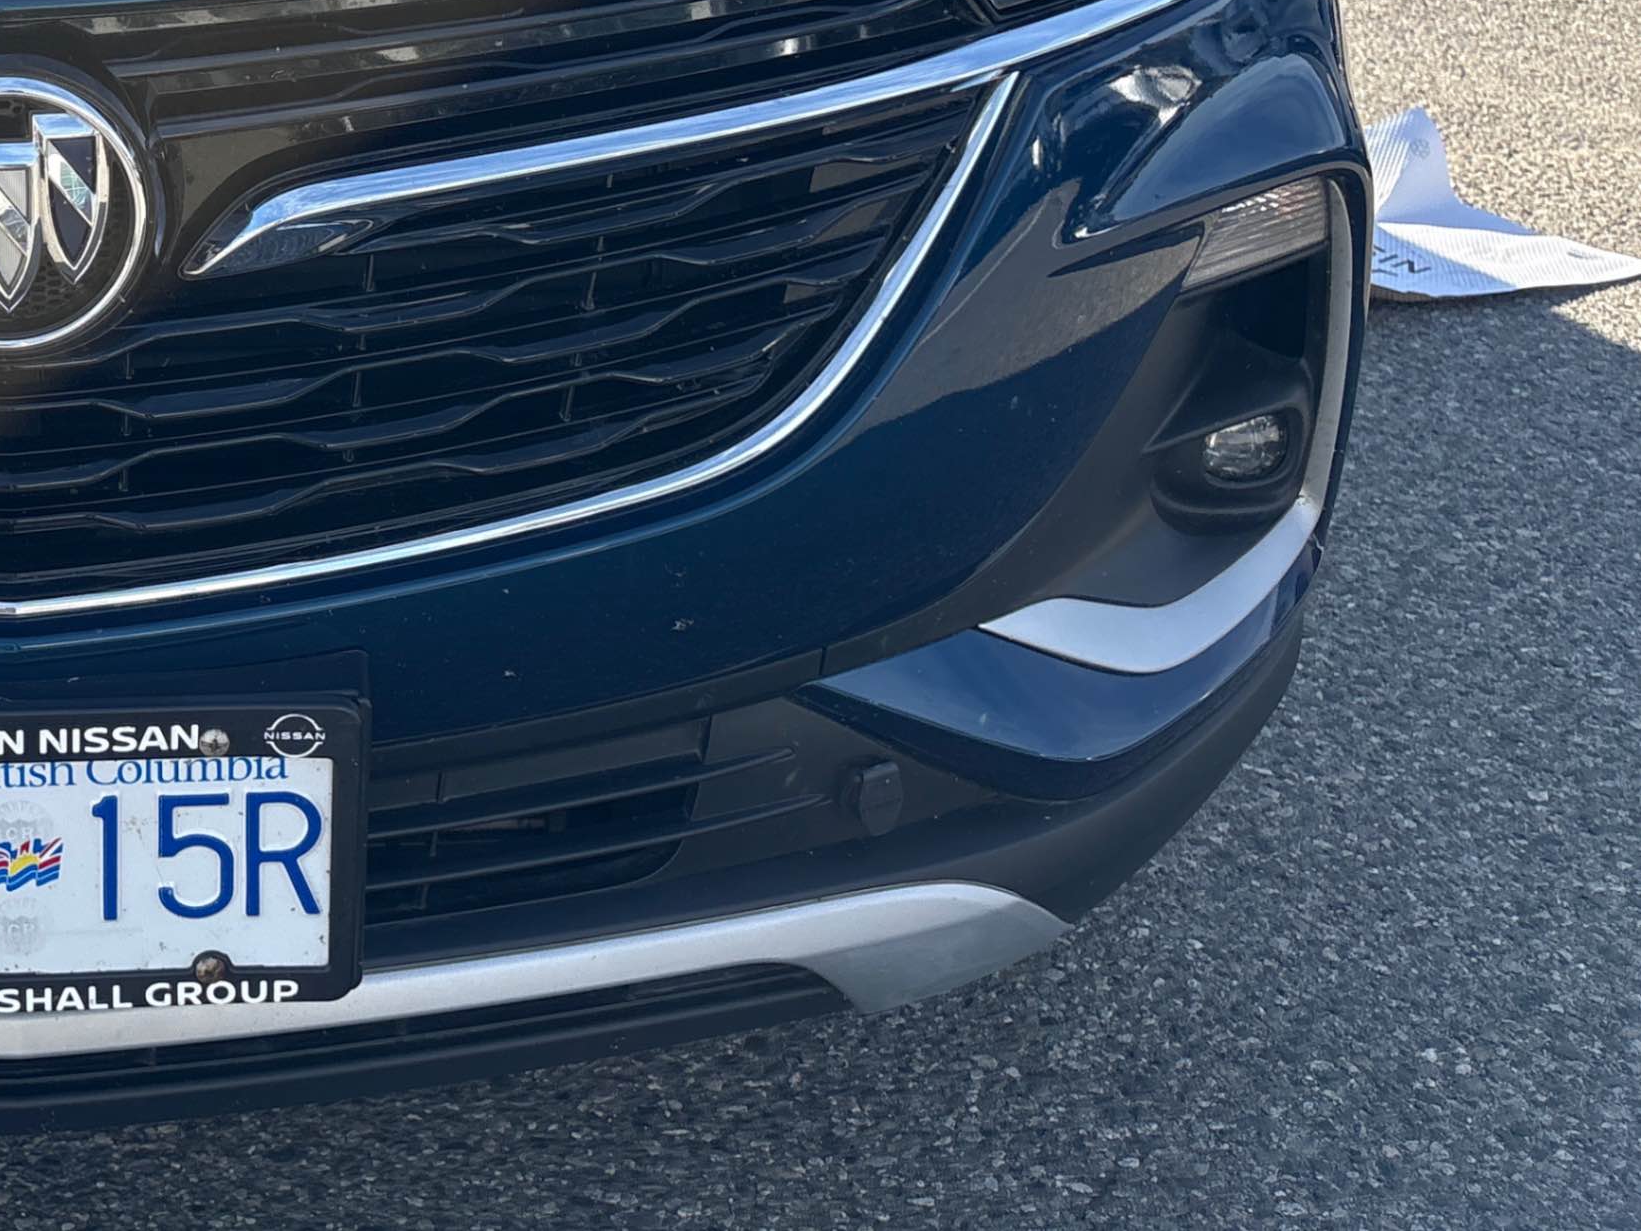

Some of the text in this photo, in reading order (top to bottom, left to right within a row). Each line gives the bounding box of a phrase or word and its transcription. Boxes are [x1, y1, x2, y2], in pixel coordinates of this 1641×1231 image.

[39, 724, 199, 755] NISSAN
[264, 731, 326, 741] NISSAN
[86, 756, 289, 785] Columbia
[91, 791, 322, 922] 15R
[144, 979, 300, 1008] GROUP
